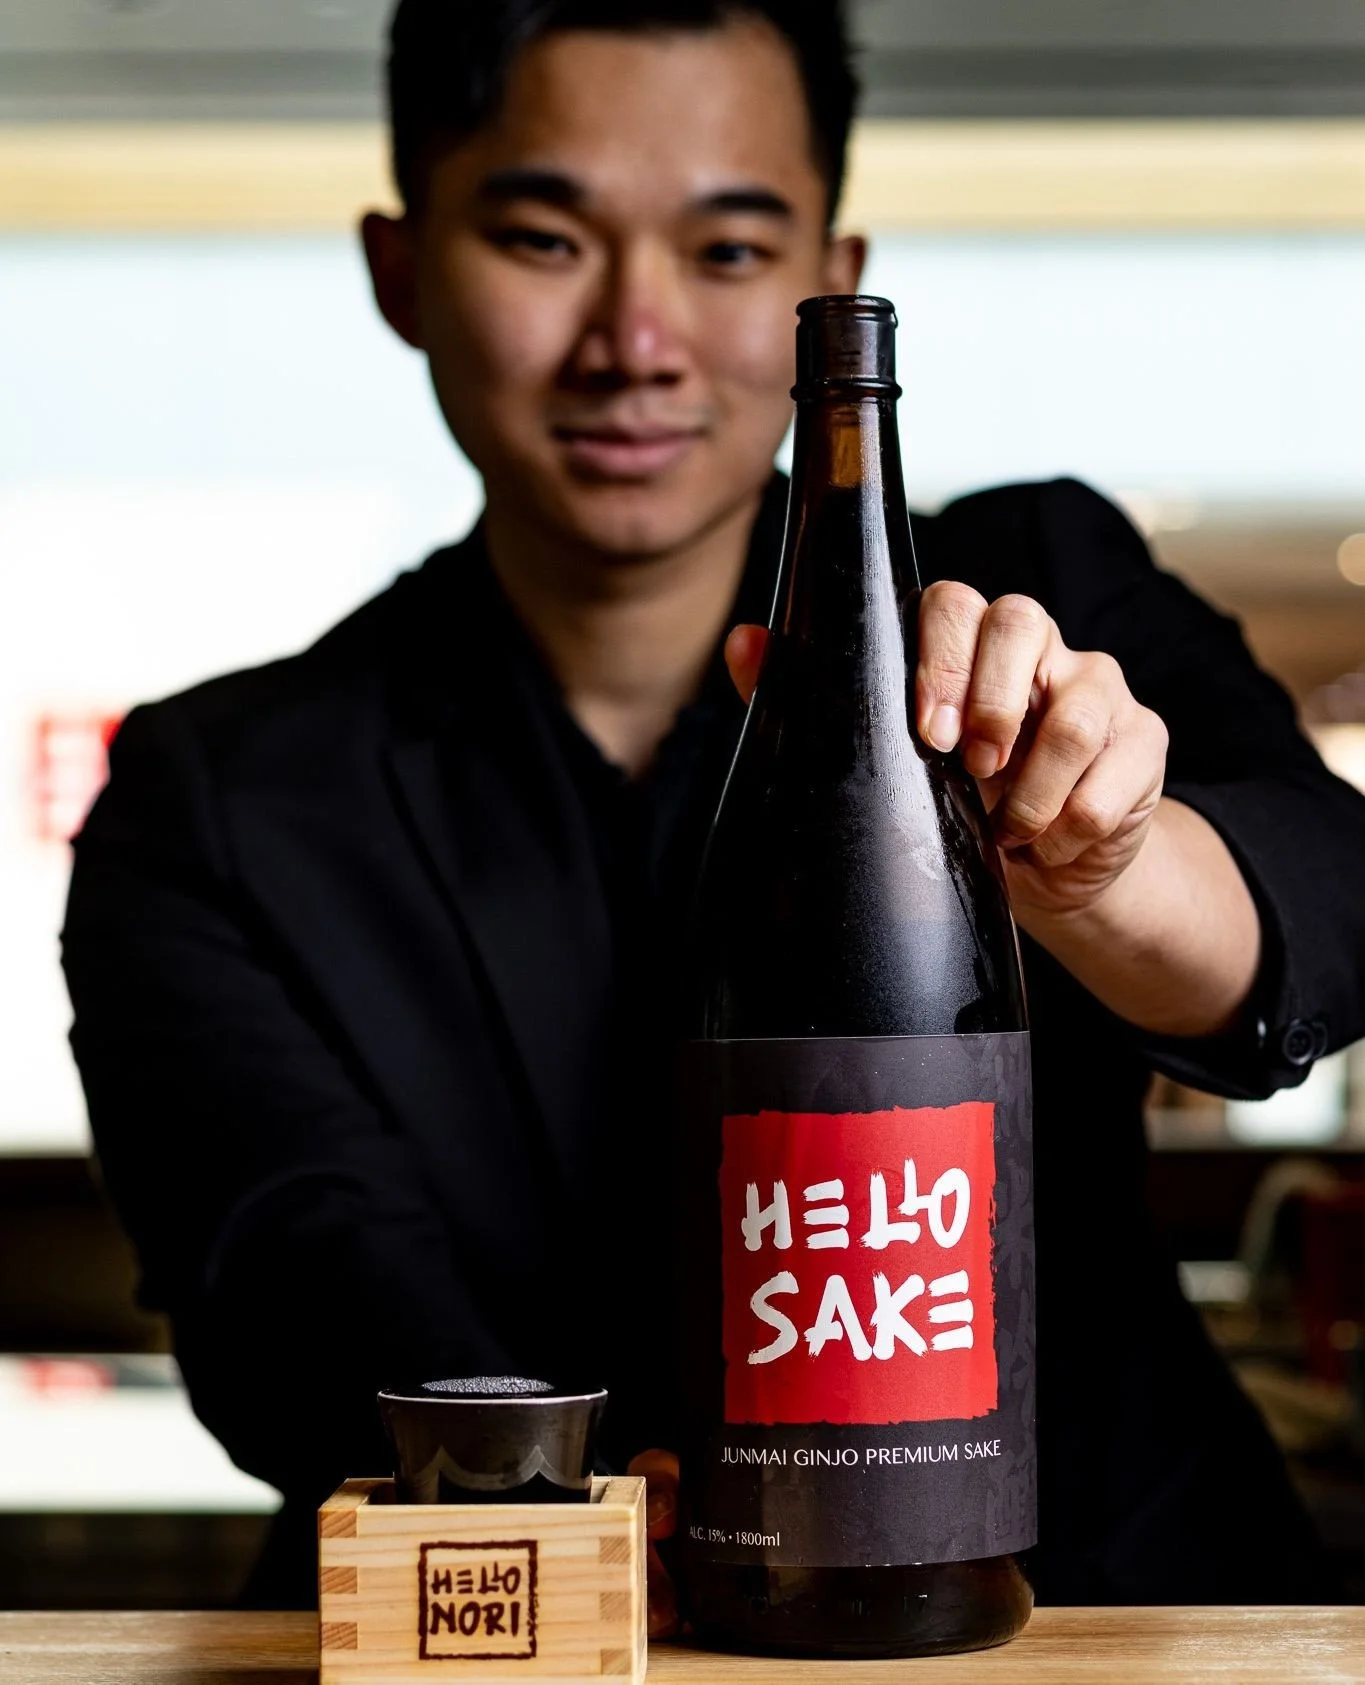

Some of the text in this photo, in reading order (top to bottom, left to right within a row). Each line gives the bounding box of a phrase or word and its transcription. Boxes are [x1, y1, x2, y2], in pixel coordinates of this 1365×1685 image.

[741, 1158, 971, 1251] HELLO
[747, 1269, 974, 1365] SAKE
[721, 1439, 1001, 1466] JUNMAI GINJO PREMIUM SAKE
[689, 1525, 780, 1547] ALC. 15% 1800ml
[431, 1562, 520, 1594] HELLO
[430, 1602, 520, 1637] NORI
